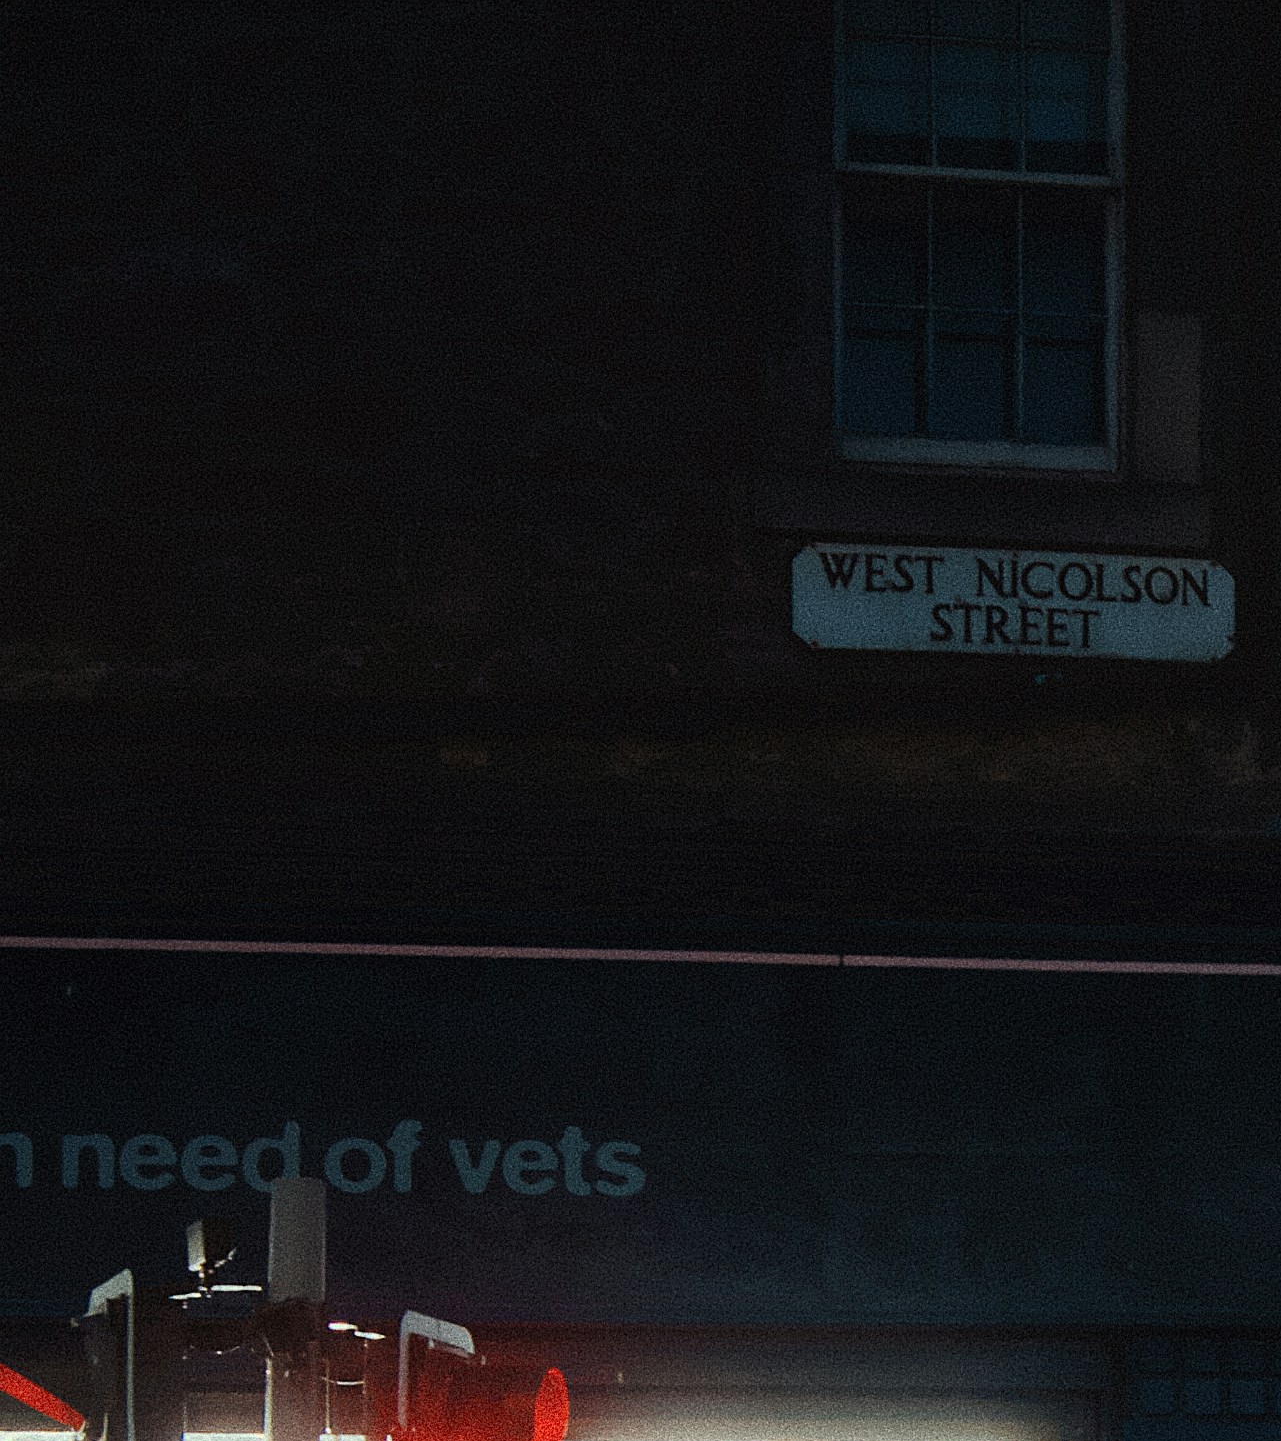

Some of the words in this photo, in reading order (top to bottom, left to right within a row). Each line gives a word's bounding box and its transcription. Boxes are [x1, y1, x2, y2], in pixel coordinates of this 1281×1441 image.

[819, 552, 944, 595] WEST
[976, 557, 1212, 607] NICOLSON
[929, 603, 1101, 649] STREET
[61, 1120, 301, 1192] need
[323, 1119, 423, 1194] of
[450, 1125, 647, 1197] vets
